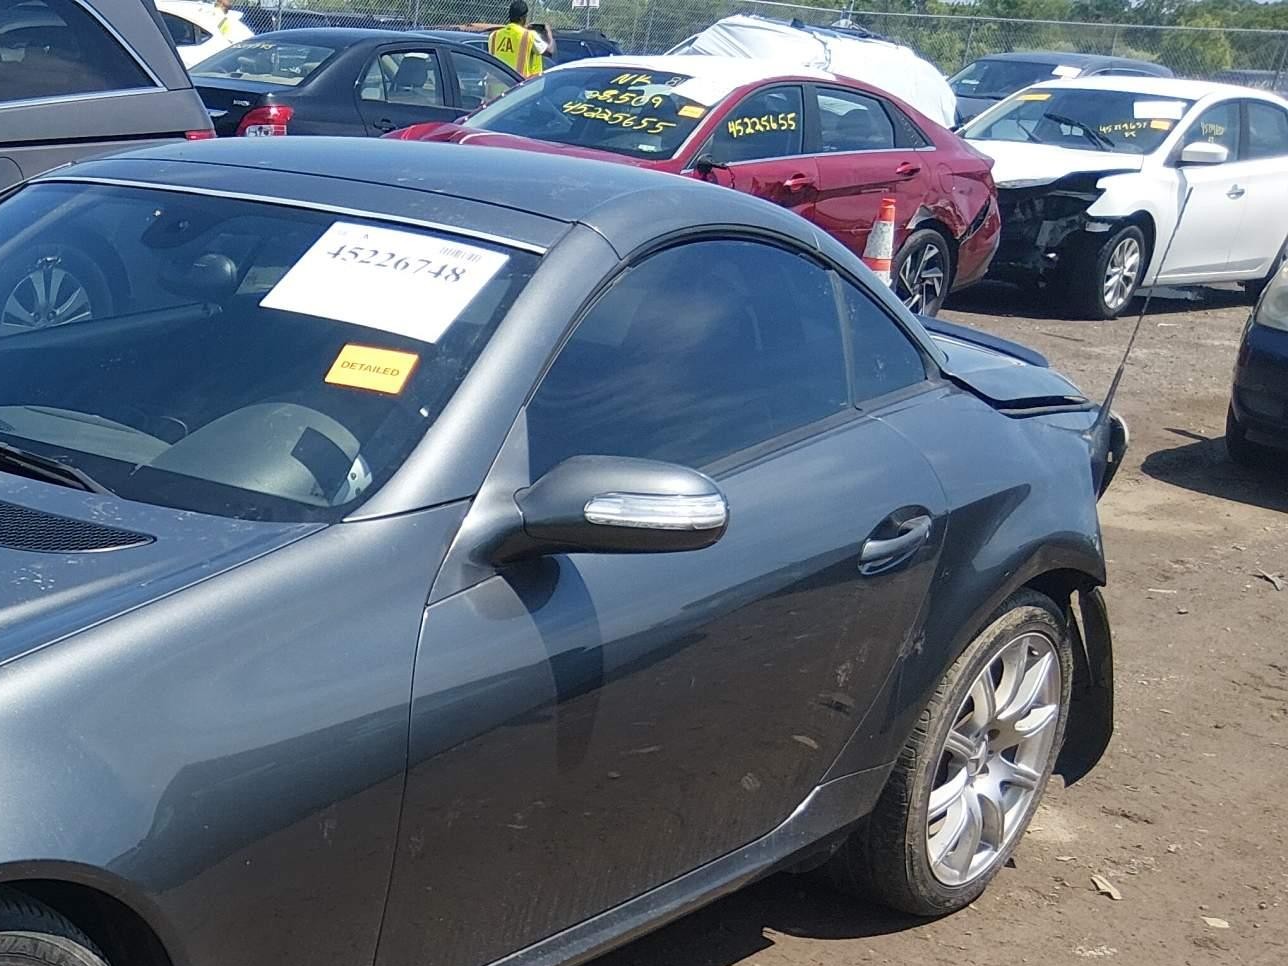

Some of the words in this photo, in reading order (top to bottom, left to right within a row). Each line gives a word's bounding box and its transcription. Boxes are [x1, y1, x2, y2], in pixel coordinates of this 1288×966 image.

[562, 100, 677, 134] 45225655
[727, 112, 797, 138] 45225655
[327, 244, 466, 283] 45226748
[340, 360, 400, 377] DETAILED
